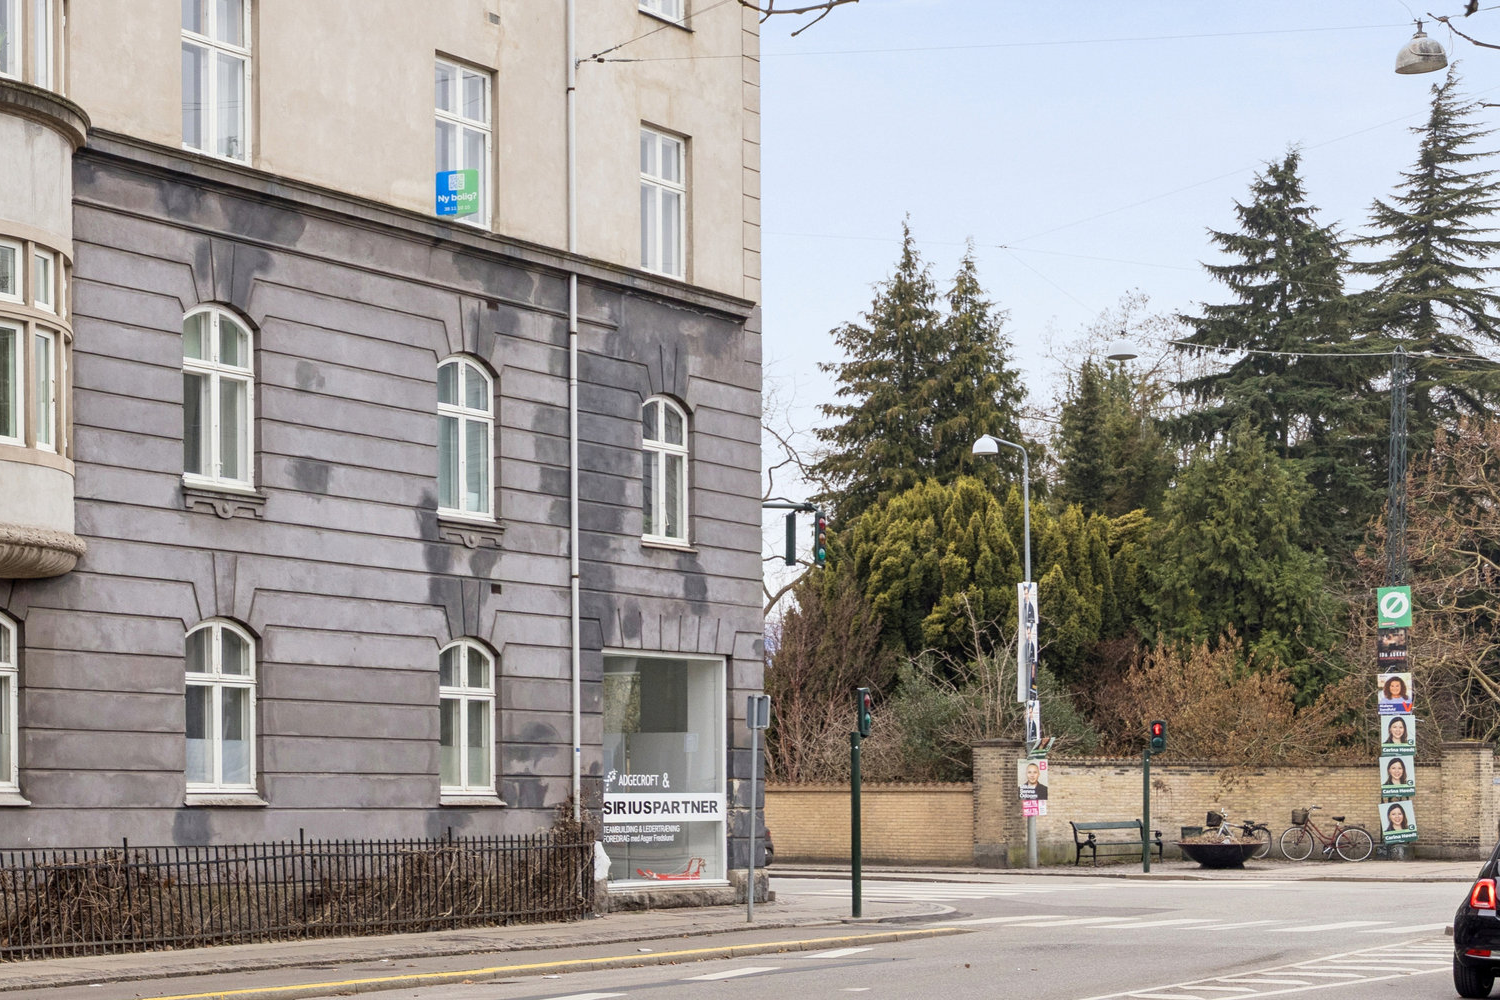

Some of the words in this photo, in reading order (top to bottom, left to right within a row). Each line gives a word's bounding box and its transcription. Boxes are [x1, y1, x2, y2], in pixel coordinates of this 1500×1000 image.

[438, 195, 449, 203] Ny
[451, 192, 477, 201] bolig?
[1039, 761, 1047, 770] B
[618, 775, 659, 786] ADGECROFT
[662, 772, 670, 788] &
[603, 800, 718, 814] SIRIUSPARTNER
[603, 825, 638, 833] TEAMBUILDING
